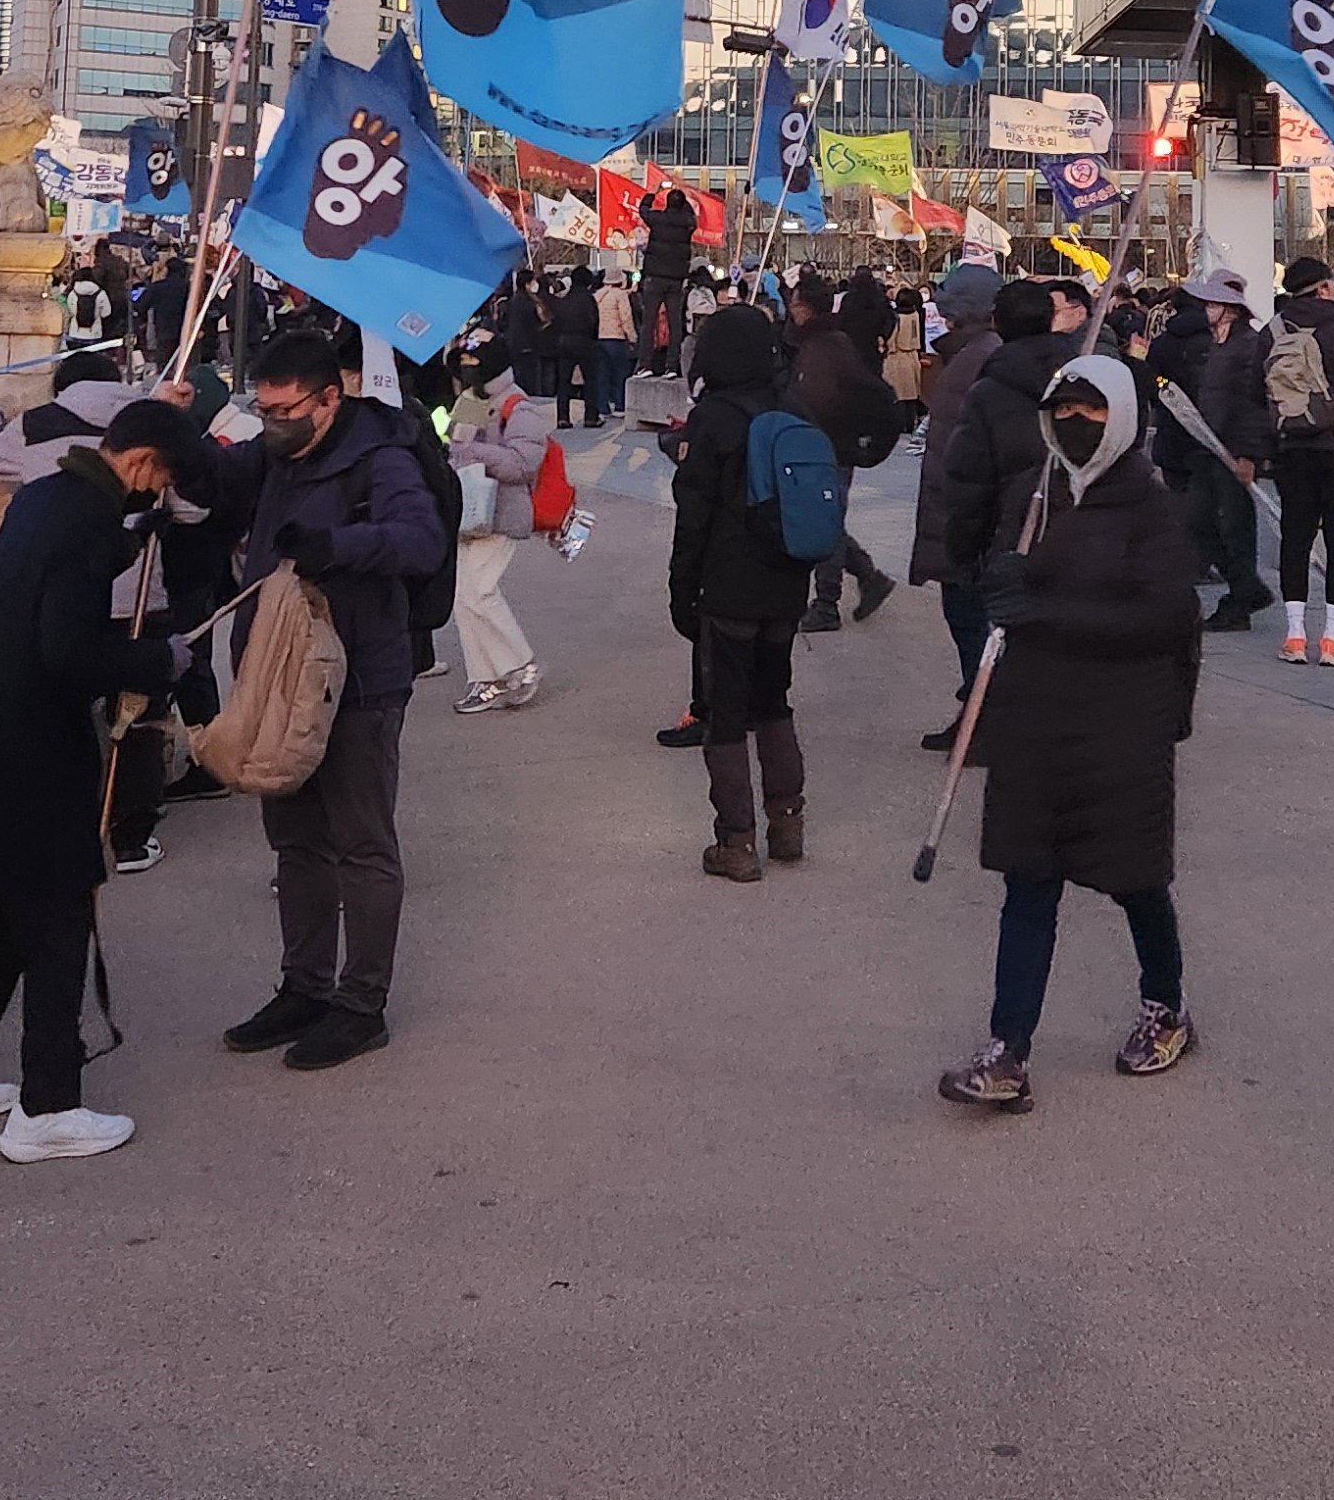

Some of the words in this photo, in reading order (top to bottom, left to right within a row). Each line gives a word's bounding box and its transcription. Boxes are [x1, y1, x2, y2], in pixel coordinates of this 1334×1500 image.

[1005, 131, 1057, 147] 민주동문회
[147, 150, 176, 186] 앙
[314, 138, 405, 226] 앙
